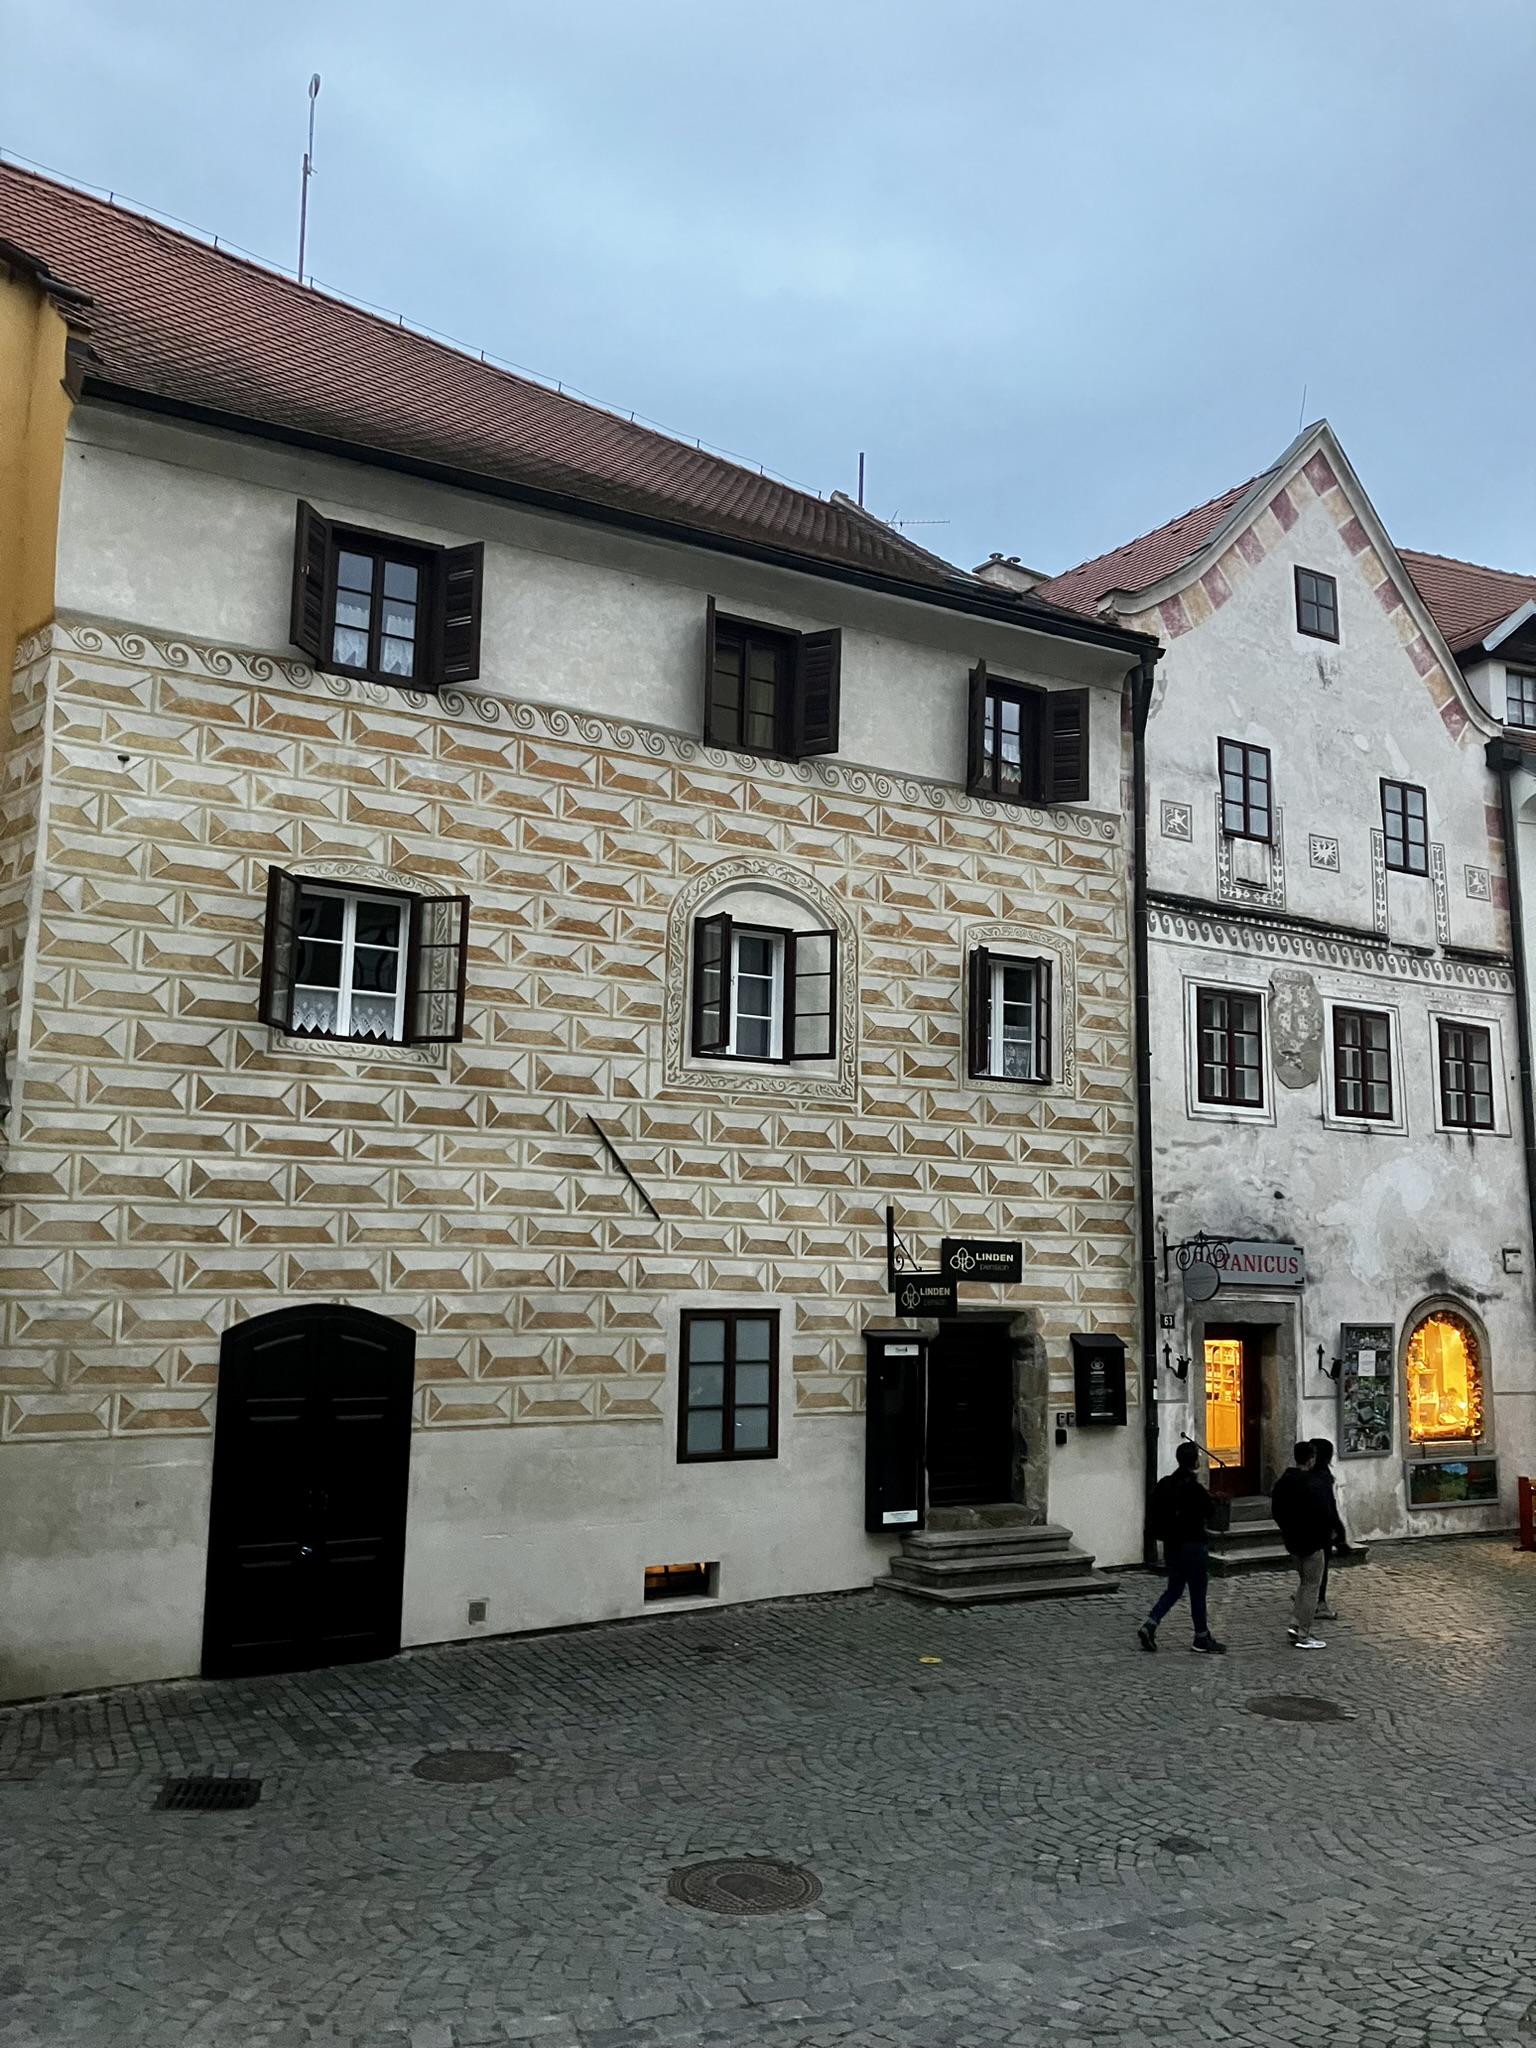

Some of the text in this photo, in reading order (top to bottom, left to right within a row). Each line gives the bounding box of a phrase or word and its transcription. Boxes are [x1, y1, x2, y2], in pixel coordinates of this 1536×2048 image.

[976, 1252, 1014, 1262] LINDEN
[1194, 1251, 1298, 1274] TANICUS
[920, 1287, 951, 1296] LINDEN
